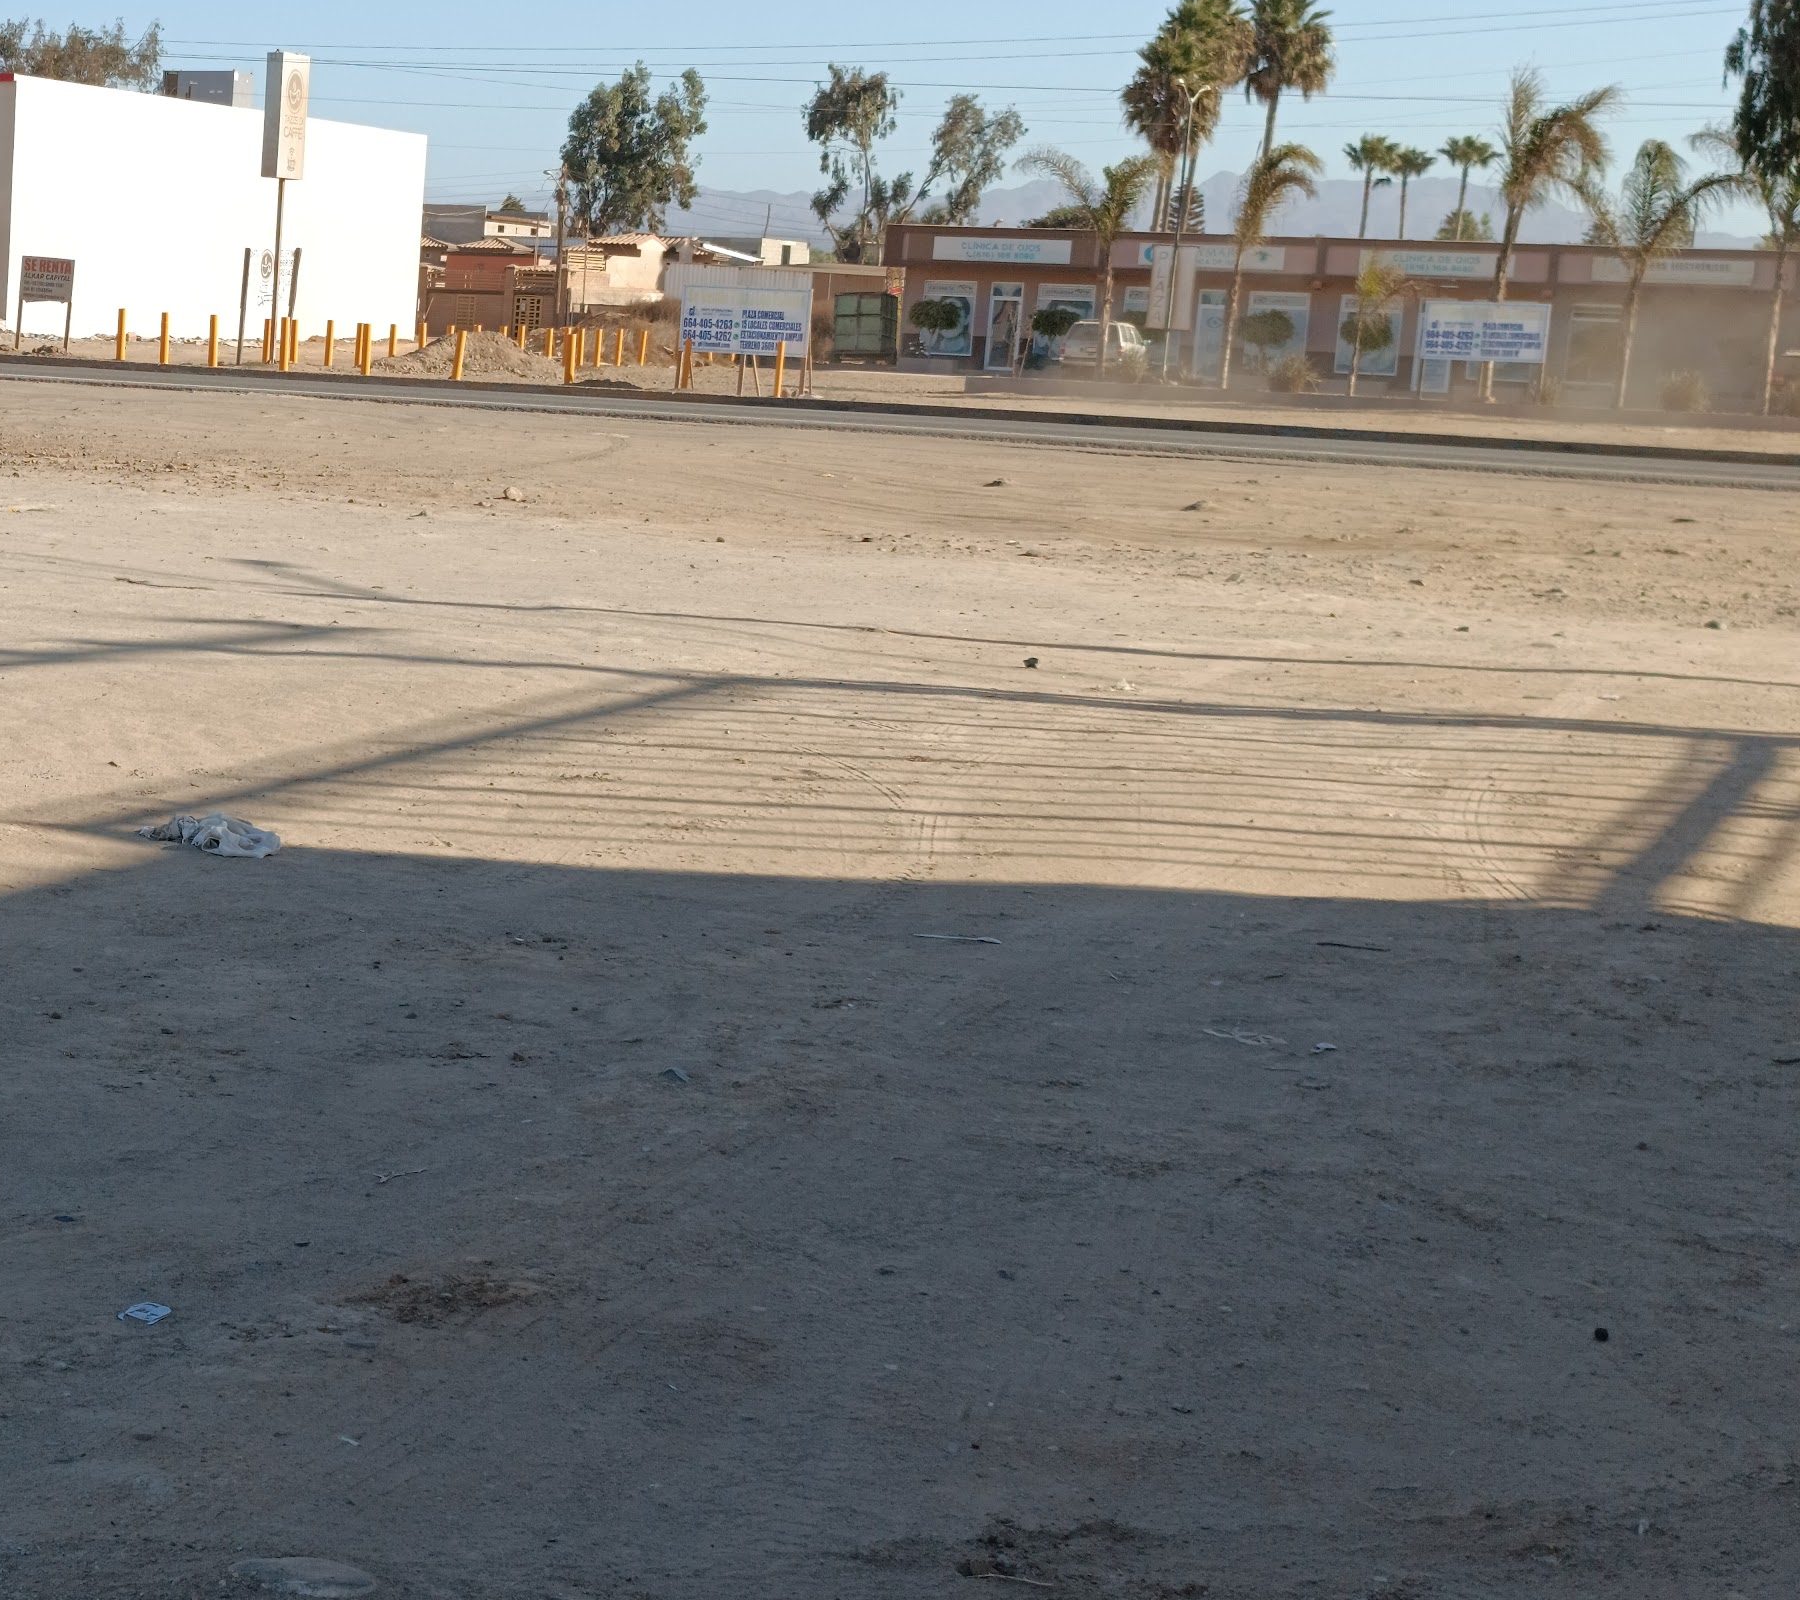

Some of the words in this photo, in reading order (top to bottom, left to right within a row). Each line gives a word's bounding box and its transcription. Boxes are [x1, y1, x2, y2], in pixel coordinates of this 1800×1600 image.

[24, 258, 37, 271] SE
[39, 260, 72, 274] RENTA
[684, 318, 732, 330] 664-405-4263
[683, 330, 731, 341] 664-405-4262
